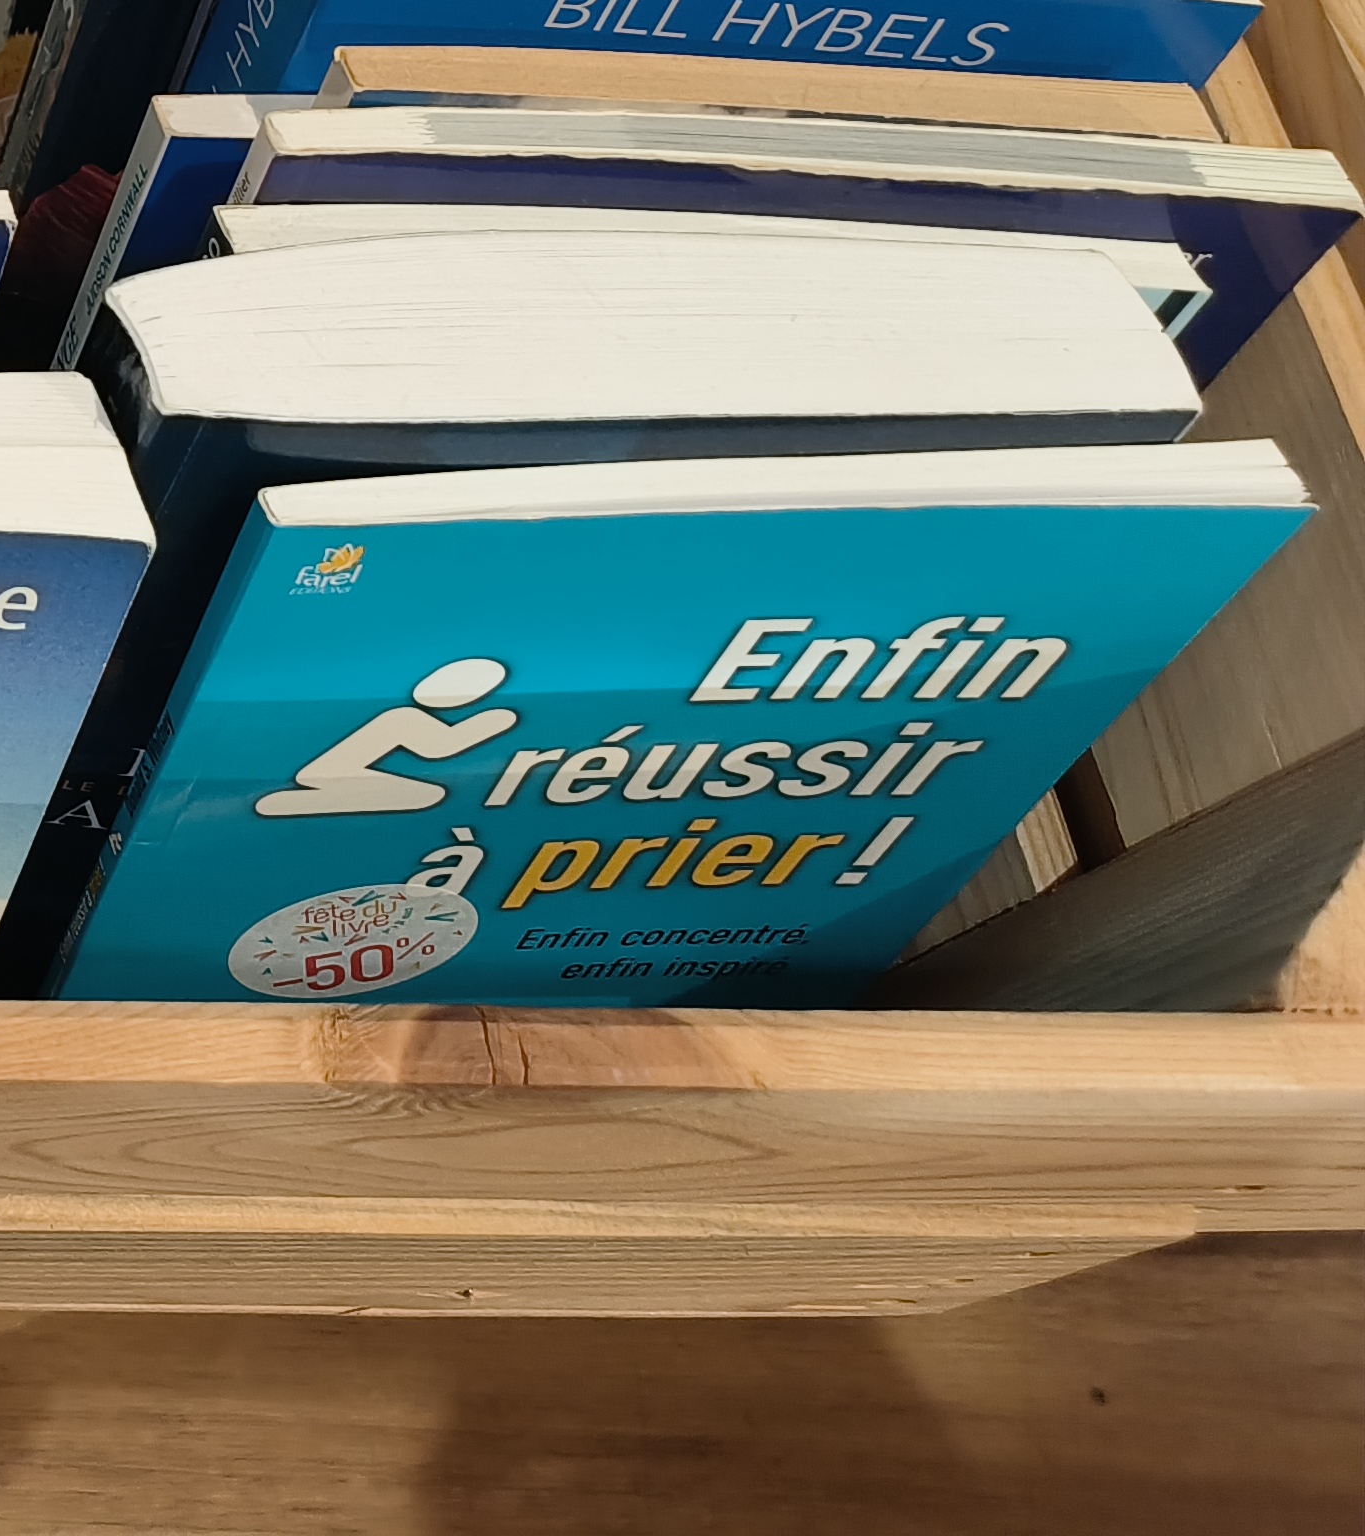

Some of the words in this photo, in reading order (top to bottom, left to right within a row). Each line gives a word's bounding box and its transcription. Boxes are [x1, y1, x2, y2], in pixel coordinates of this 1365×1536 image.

[86, 254, 112, 317] JUDSON
[108, 163, 149, 255] CORNWALL
[295, 564, 363, 588] farel
[689, 614, 1069, 707] Enfin
[484, 721, 984, 809] réussir
[407, 827, 485, 896] à
[499, 817, 842, 910] prier
[301, 904, 356, 925] fête
[362, 899, 398, 918] du
[332, 913, 389, 937] livre
[516, 926, 610, 951] Enfin
[272, 931, 435, 991] -50%
[560, 956, 654, 980] enfin
[663, 955, 791, 982] inspiré
